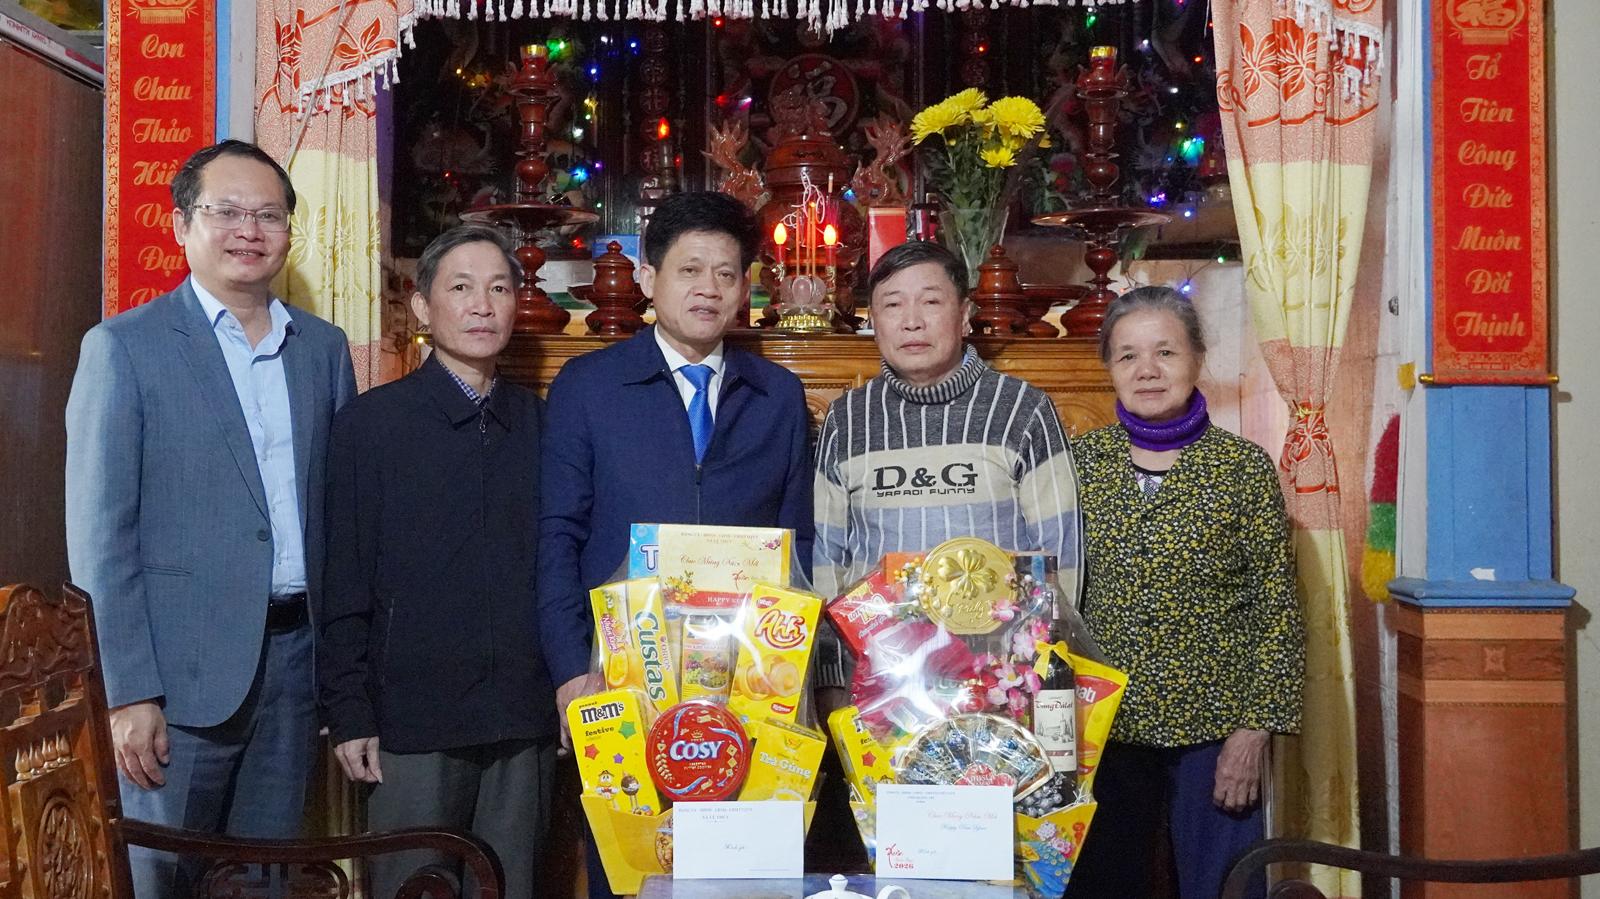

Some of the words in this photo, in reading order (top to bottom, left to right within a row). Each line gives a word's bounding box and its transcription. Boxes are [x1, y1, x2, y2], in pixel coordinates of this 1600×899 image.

[141, 33, 185, 59] Con
[1466, 52, 1502, 80] Tổ
[133, 76, 193, 101] Cháu
[1460, 97, 1515, 123] Tiên
[132, 118, 194, 144] Thảo
[1458, 140, 1520, 172] Công
[133, 160, 179, 186] Hiề
[1463, 183, 1513, 209] Đức
[134, 203, 174, 234] Vạ
[138, 245, 186, 277] Đại
[1465, 268, 1513, 295] Đời
[1453, 311, 1527, 344] Thịnh
[872, 463, 978, 490] D&G
[635, 611, 667, 700] Custas
[585, 726, 614, 737] festive
[669, 740, 725, 761] COSY
